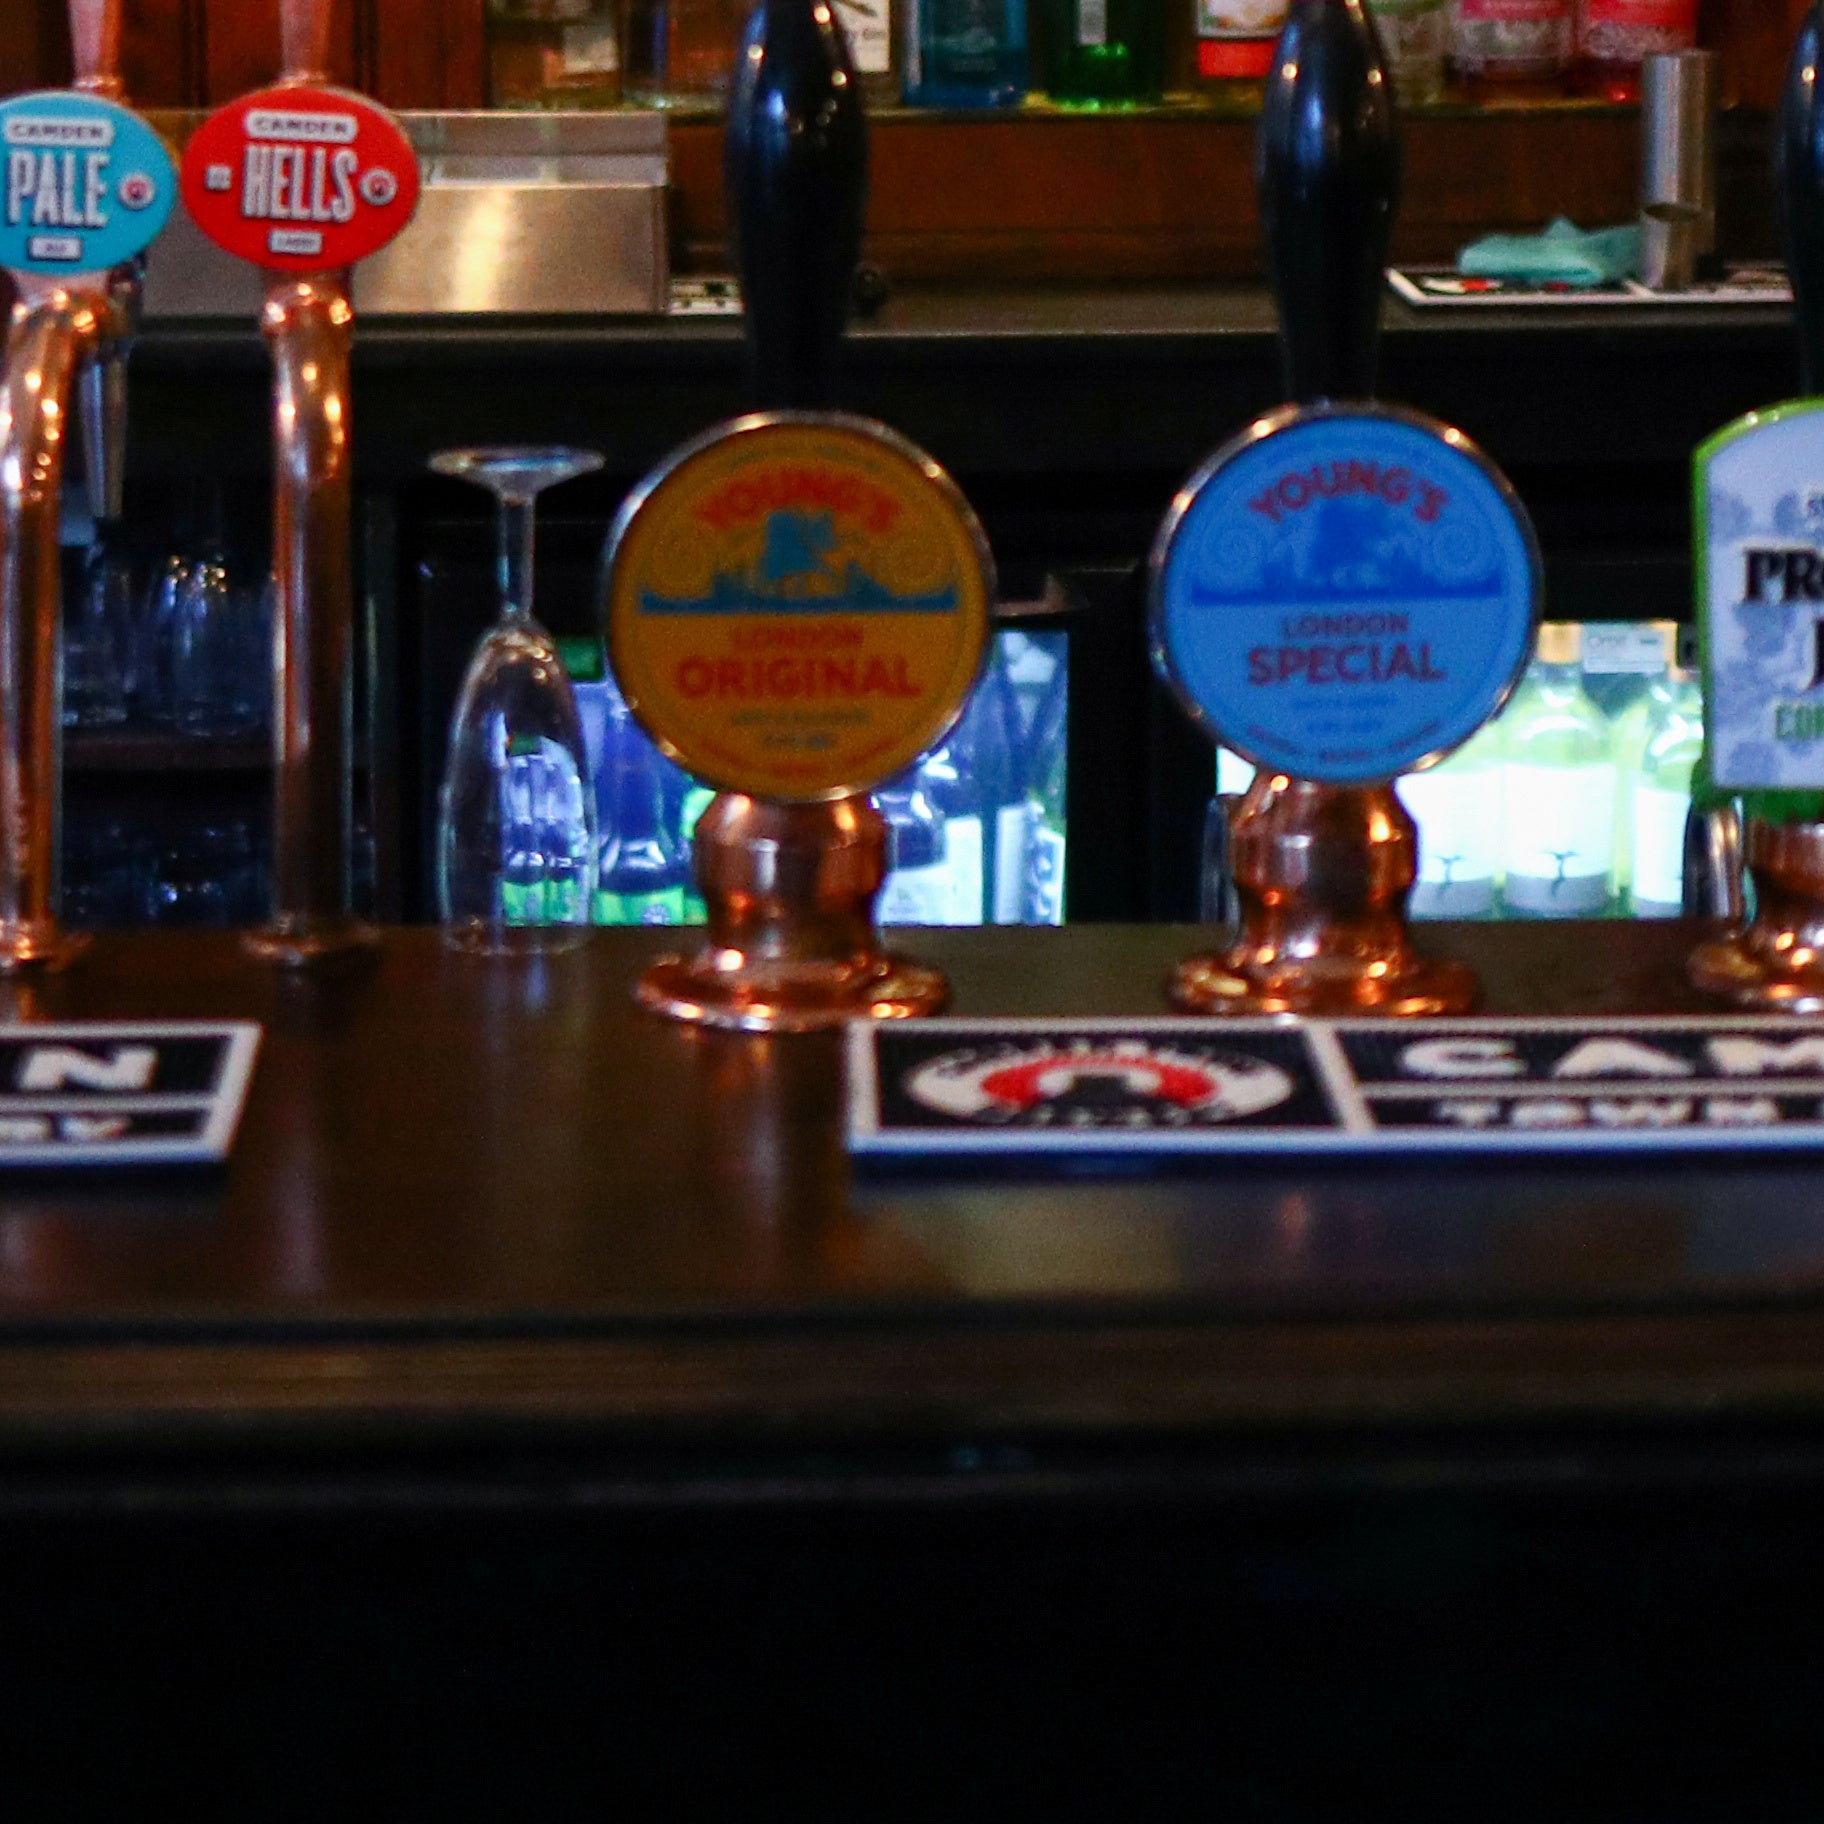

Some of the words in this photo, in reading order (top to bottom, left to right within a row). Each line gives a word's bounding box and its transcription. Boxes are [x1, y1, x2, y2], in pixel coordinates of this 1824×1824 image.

[11, 124, 104, 138] CAMDEN
[253, 116, 348, 134] CAMDEN
[7, 148, 110, 227] PALE
[242, 145, 358, 224] HELLS
[696, 467, 902, 534] YOUNG'S
[1248, 459, 1452, 523] YOUNG'S
[730, 624, 864, 650] LONDON
[1280, 612, 1409, 639] LONDON
[674, 654, 922, 699] ORIGINAL
[1247, 642, 1449, 685] SPECIAL
[1436, 1095, 1778, 1129] TOWN
